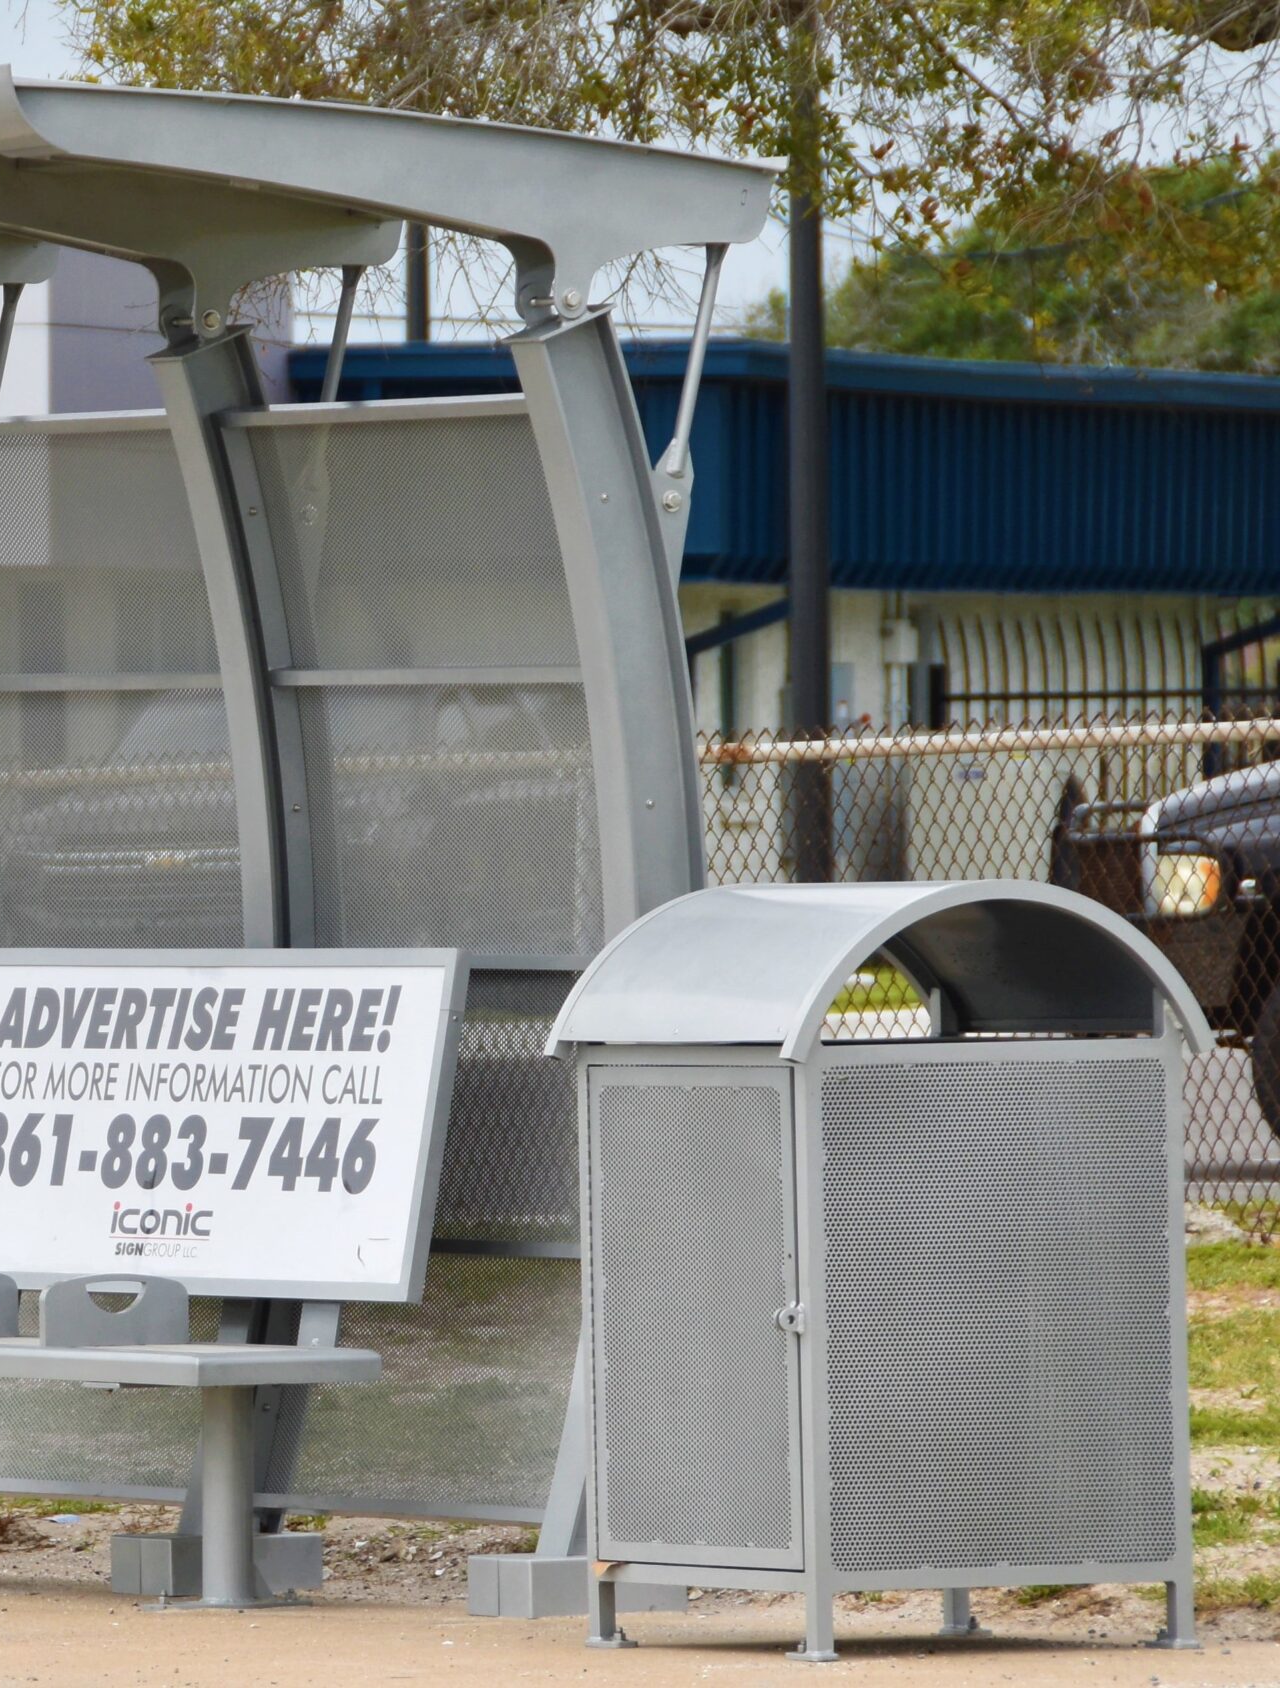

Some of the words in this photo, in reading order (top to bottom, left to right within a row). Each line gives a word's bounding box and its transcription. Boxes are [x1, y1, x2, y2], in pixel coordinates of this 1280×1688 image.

[252, 985, 402, 1053] HERE!
[43, 1062, 119, 1102] MORE
[125, 1062, 317, 1104] INFORMATION
[321, 1064, 383, 1105] CALL
[110, 1201, 213, 1237] iconic
